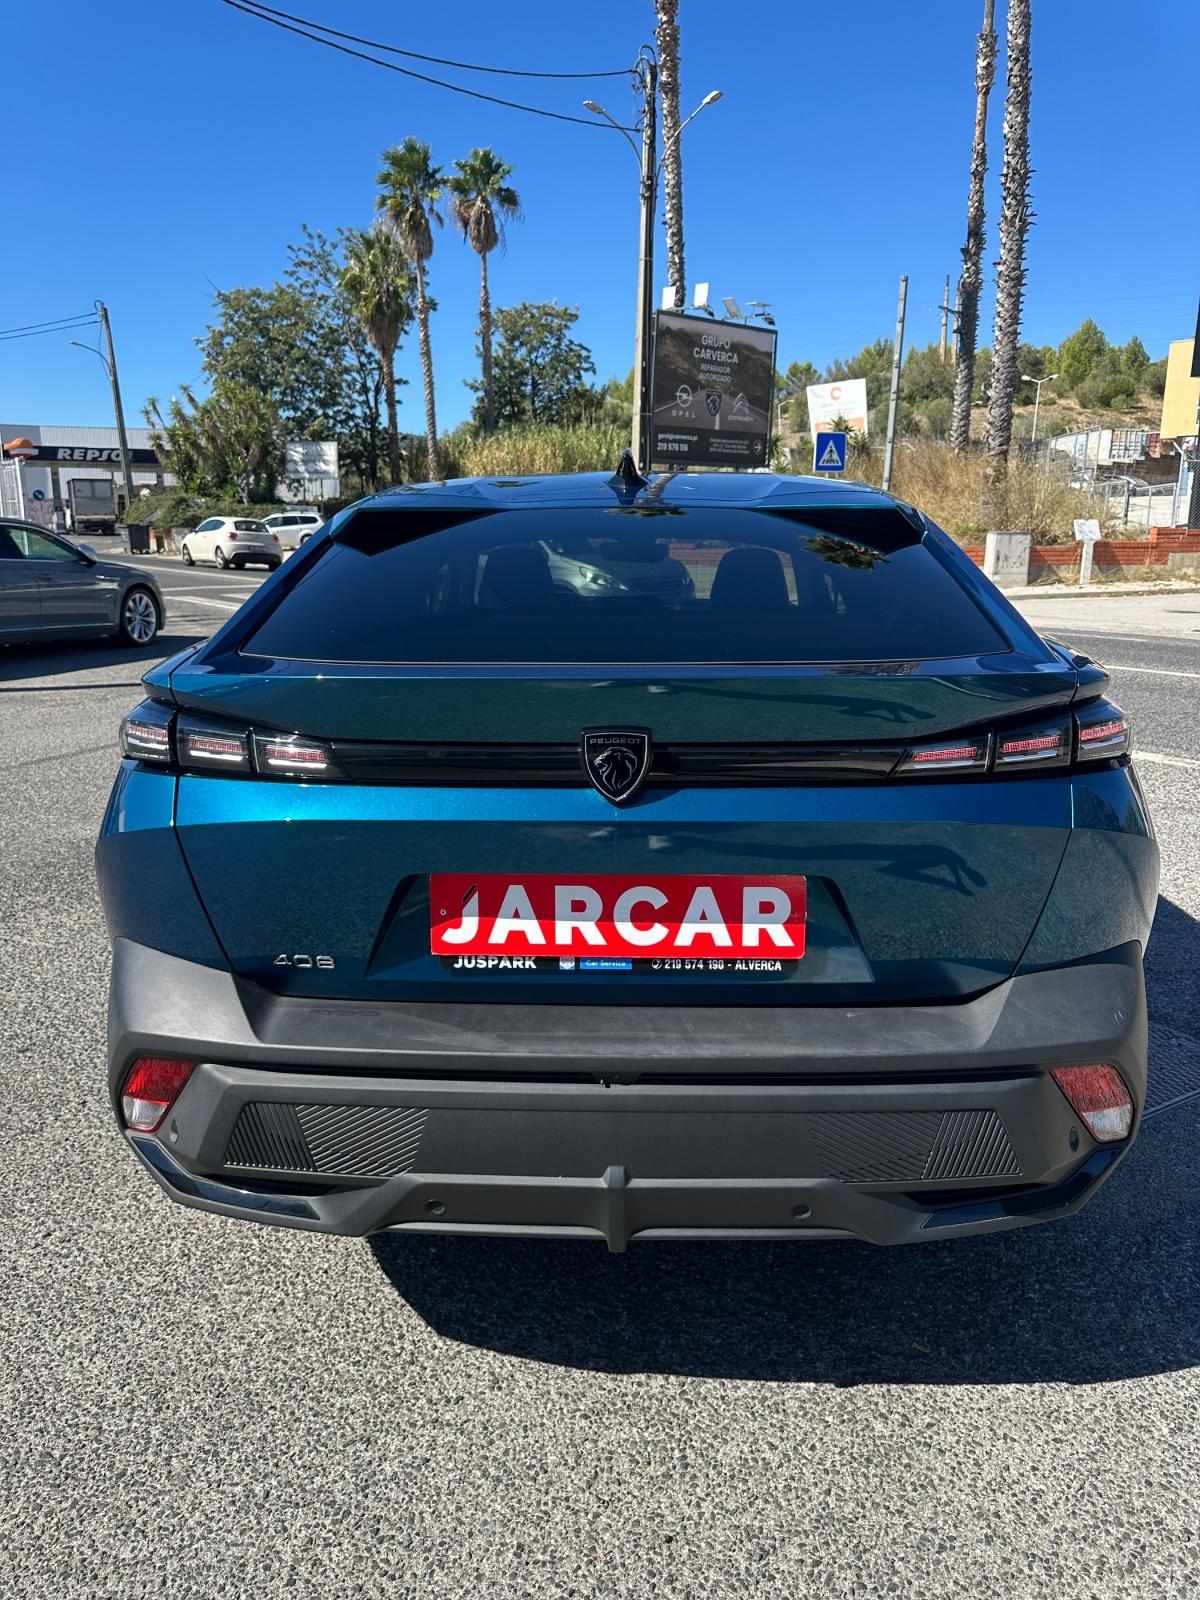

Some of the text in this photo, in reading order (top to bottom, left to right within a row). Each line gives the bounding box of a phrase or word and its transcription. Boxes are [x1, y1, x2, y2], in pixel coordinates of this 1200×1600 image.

[702, 335, 730, 349] GRUPO
[693, 347, 738, 364] CARVERCA
[590, 736, 641, 744] PEUGEOT
[441, 884, 795, 947] JARCAR
[273, 954, 335, 968] 408
[453, 956, 537, 969] JUSPARK
[664, 959, 682, 969] 219
[684, 959, 704, 969] 574
[707, 959, 725, 969] 190
[735, 960, 782, 971] ALVERCA
